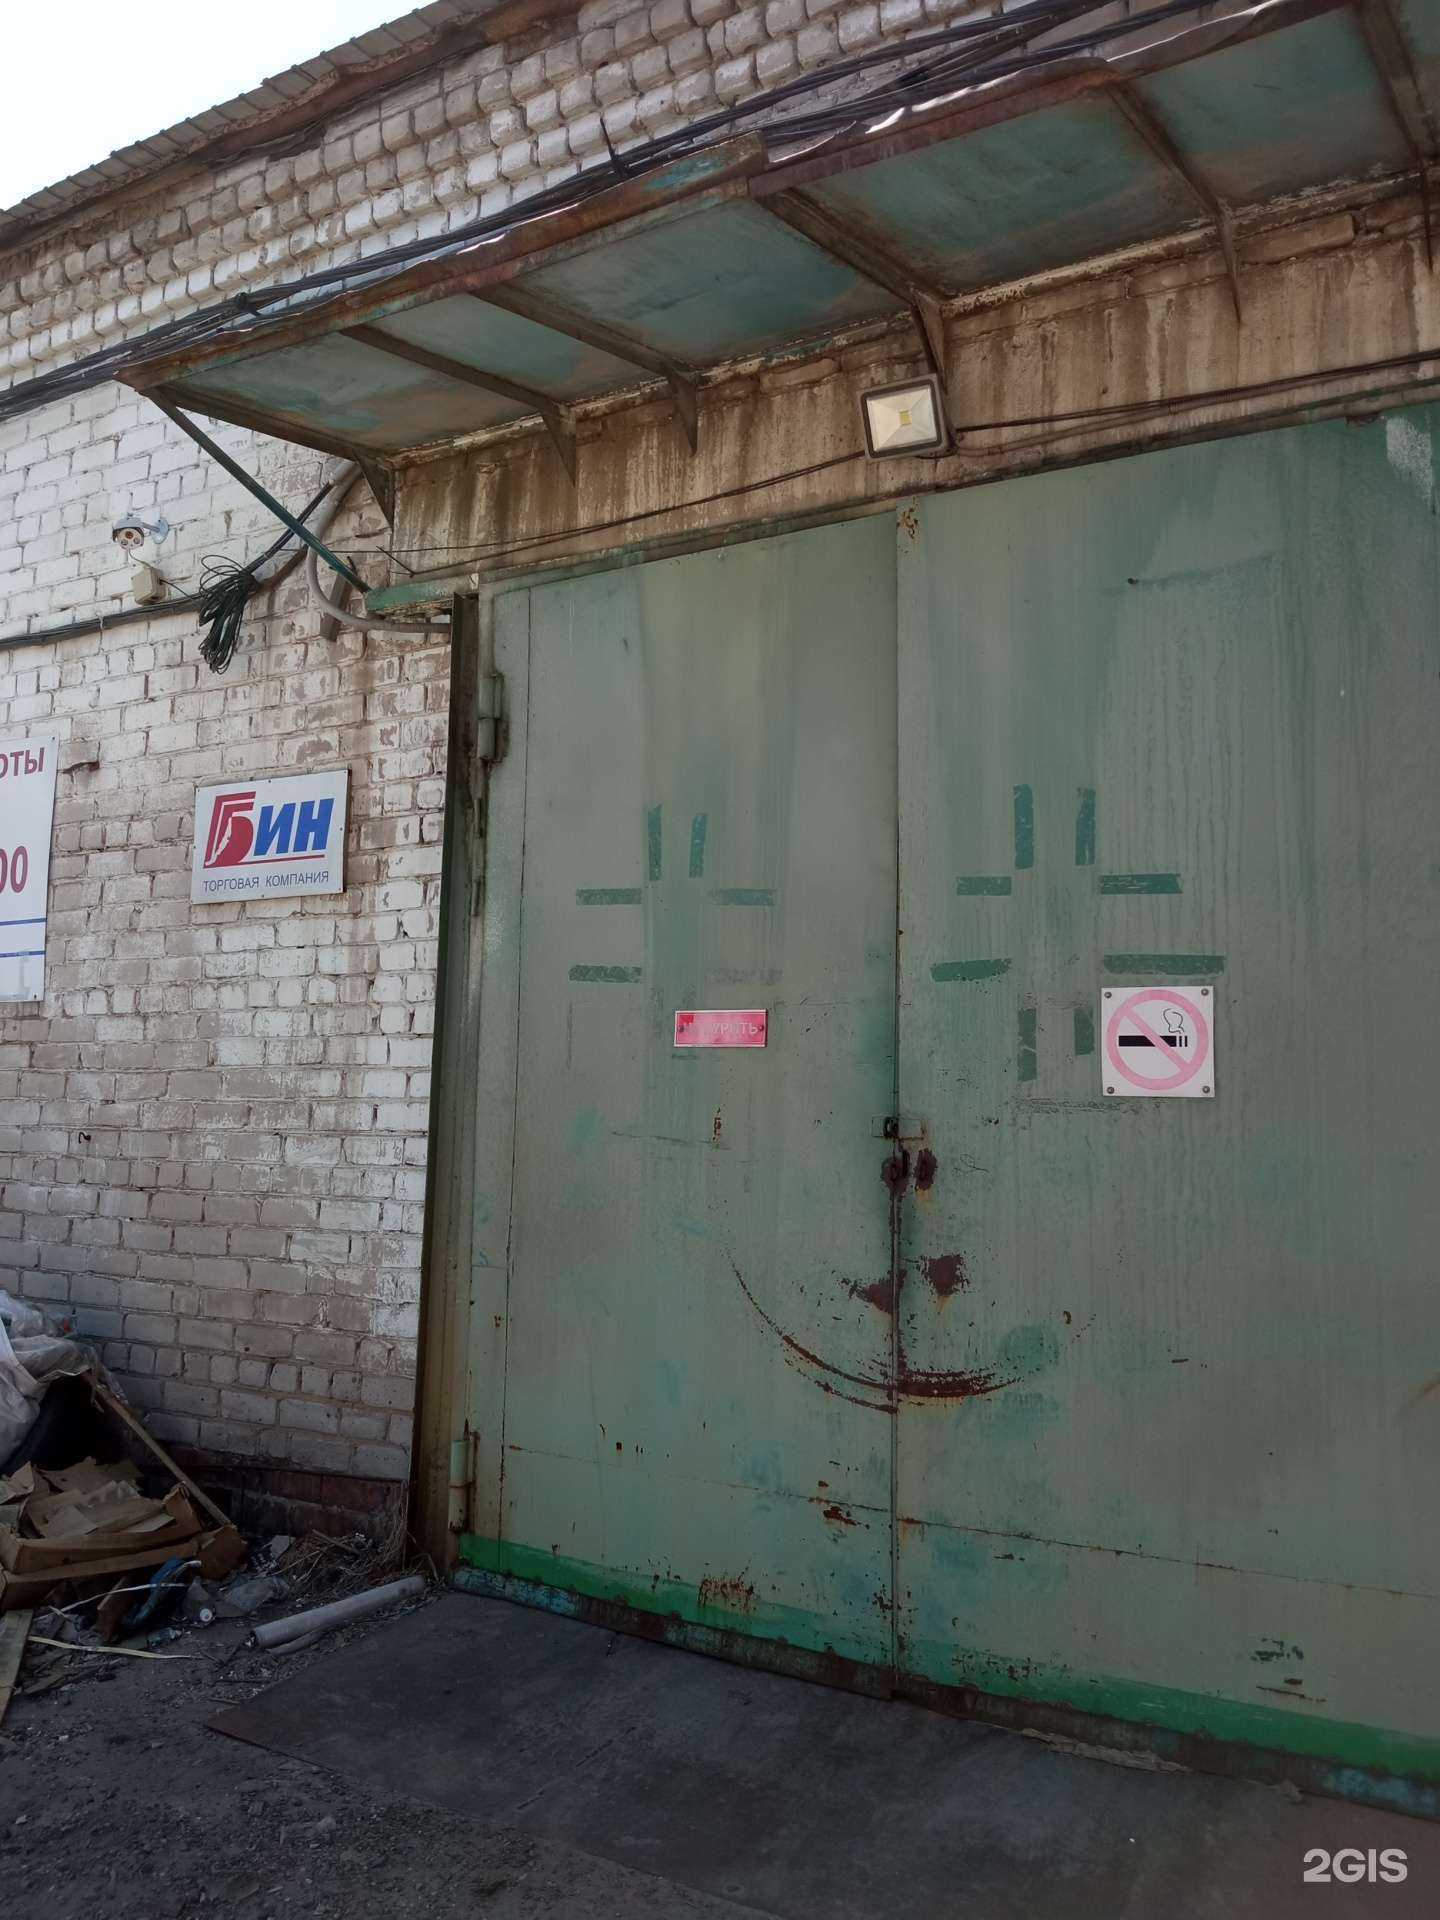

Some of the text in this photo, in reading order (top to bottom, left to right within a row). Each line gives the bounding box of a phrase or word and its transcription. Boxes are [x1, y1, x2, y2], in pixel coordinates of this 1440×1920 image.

[203, 791, 335, 869] БИН
[203, 870, 330, 893] ТОРГОВАЯ КОМПАНИЯ
